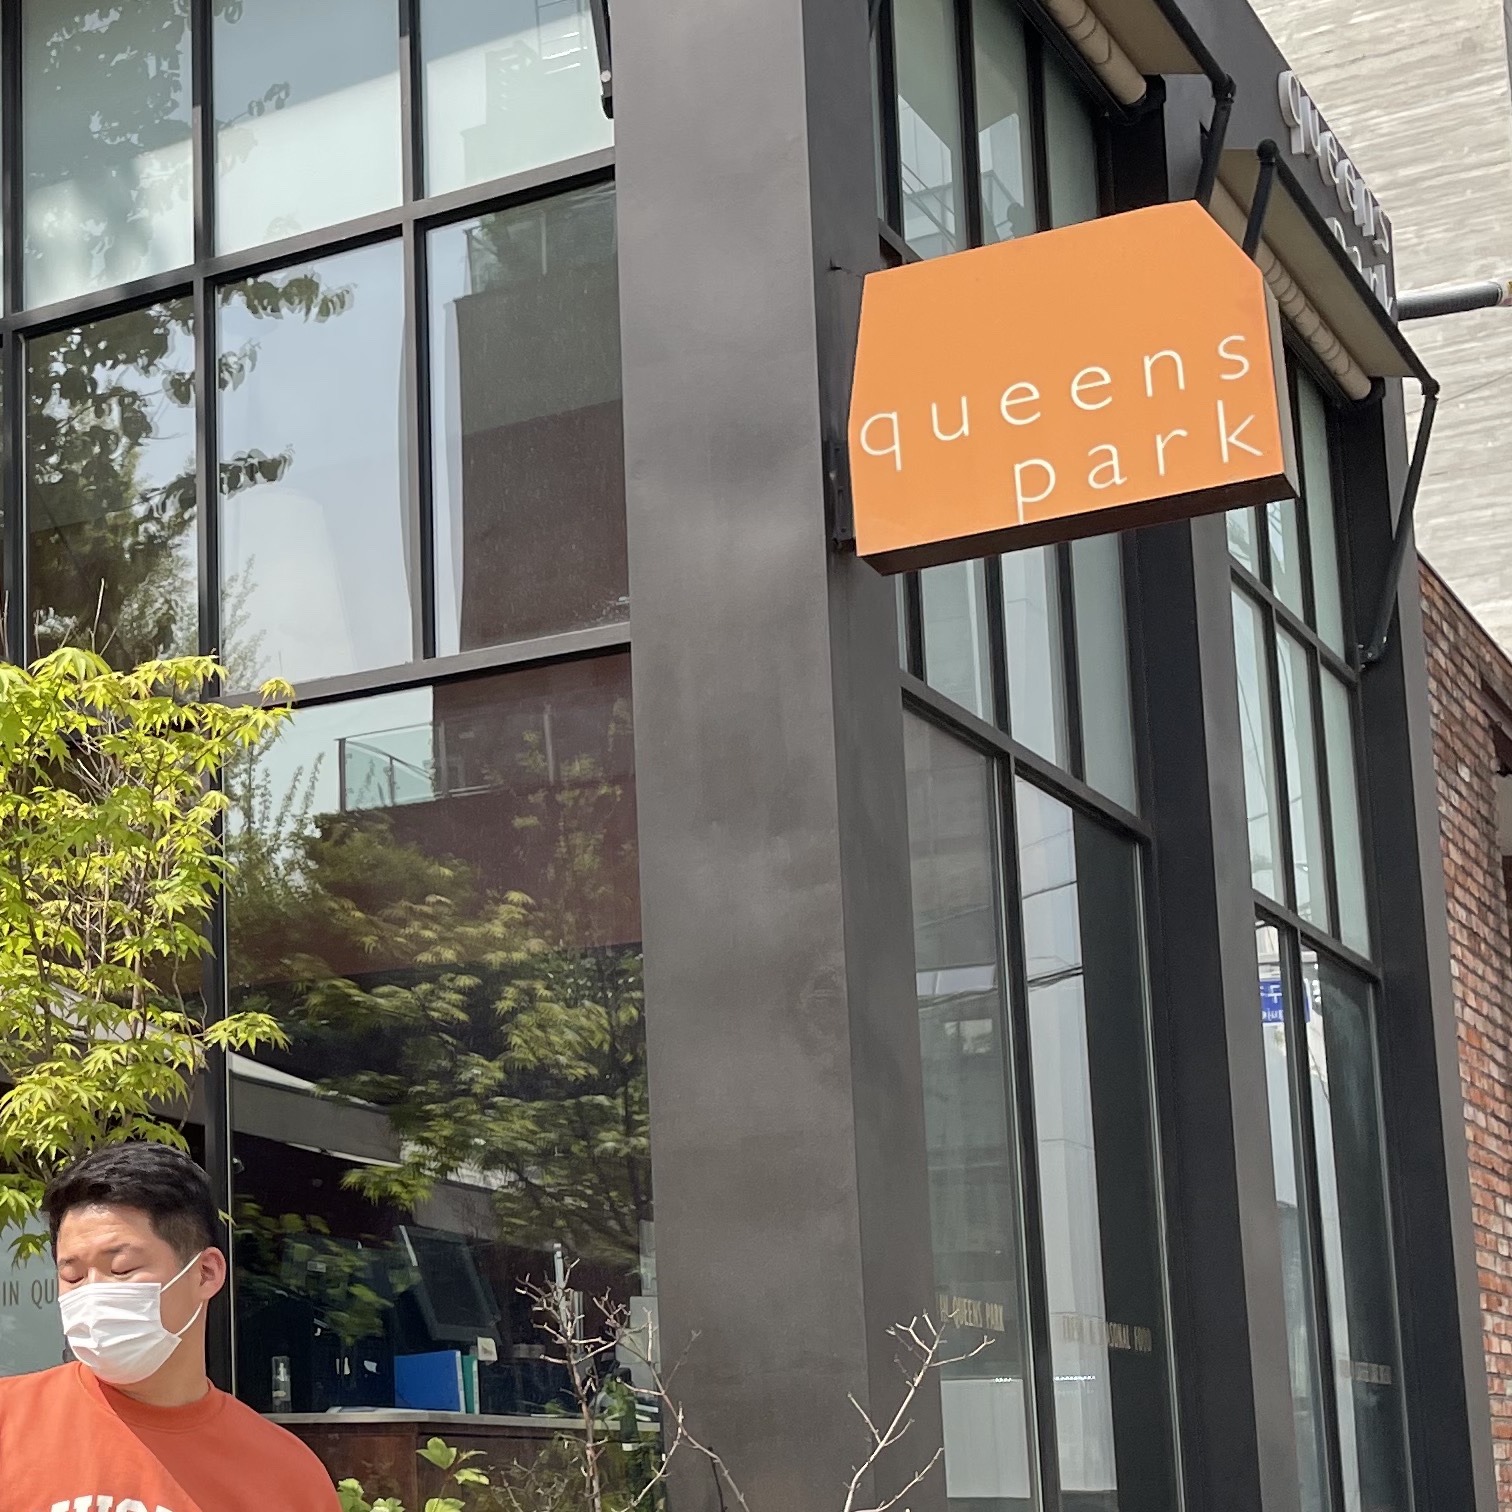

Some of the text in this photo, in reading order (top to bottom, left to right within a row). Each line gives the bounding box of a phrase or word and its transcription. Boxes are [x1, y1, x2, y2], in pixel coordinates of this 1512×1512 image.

[859, 334, 1251, 471] queens
[1014, 400, 1263, 524] park
[2, 1280, 19, 1307] IN
